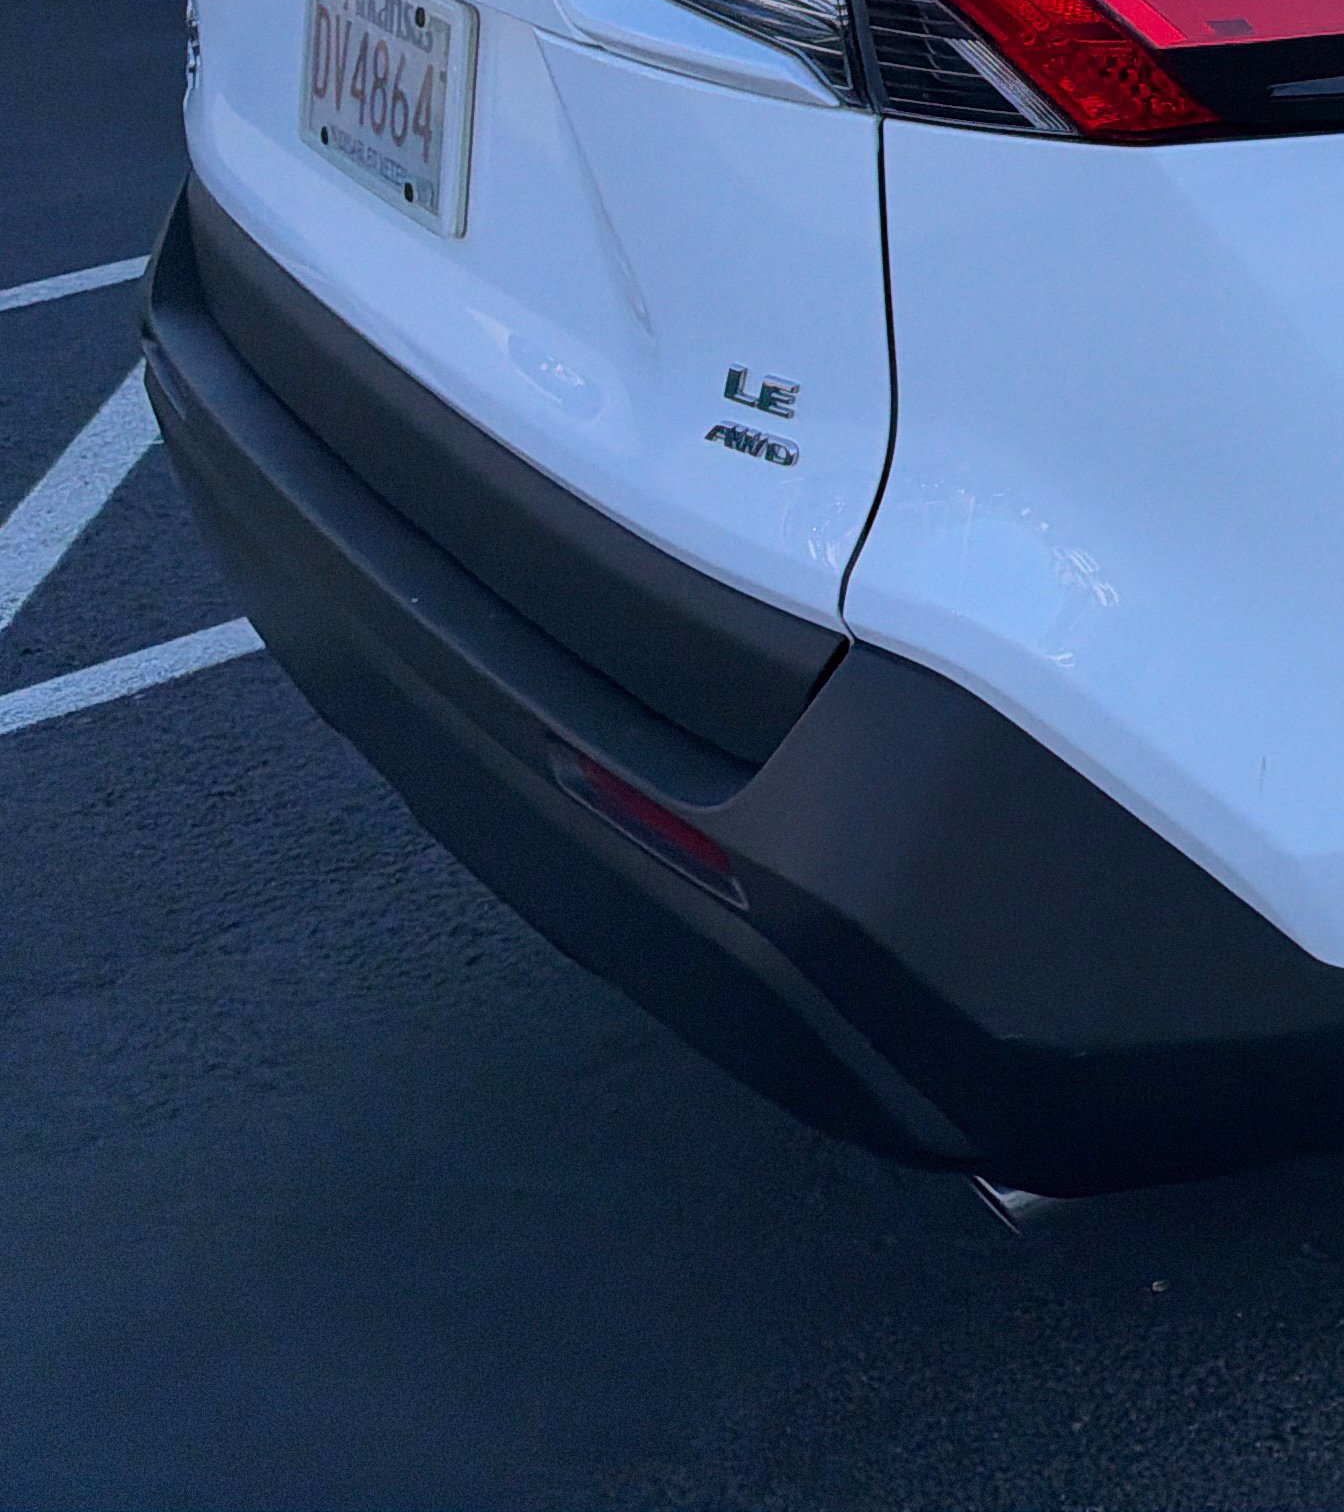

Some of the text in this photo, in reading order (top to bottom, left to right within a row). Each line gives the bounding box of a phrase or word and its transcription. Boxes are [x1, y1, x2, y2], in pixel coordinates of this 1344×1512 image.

[312, 3, 434, 164] DV4864
[724, 363, 801, 419] LE
[704, 420, 800, 467] AWD
